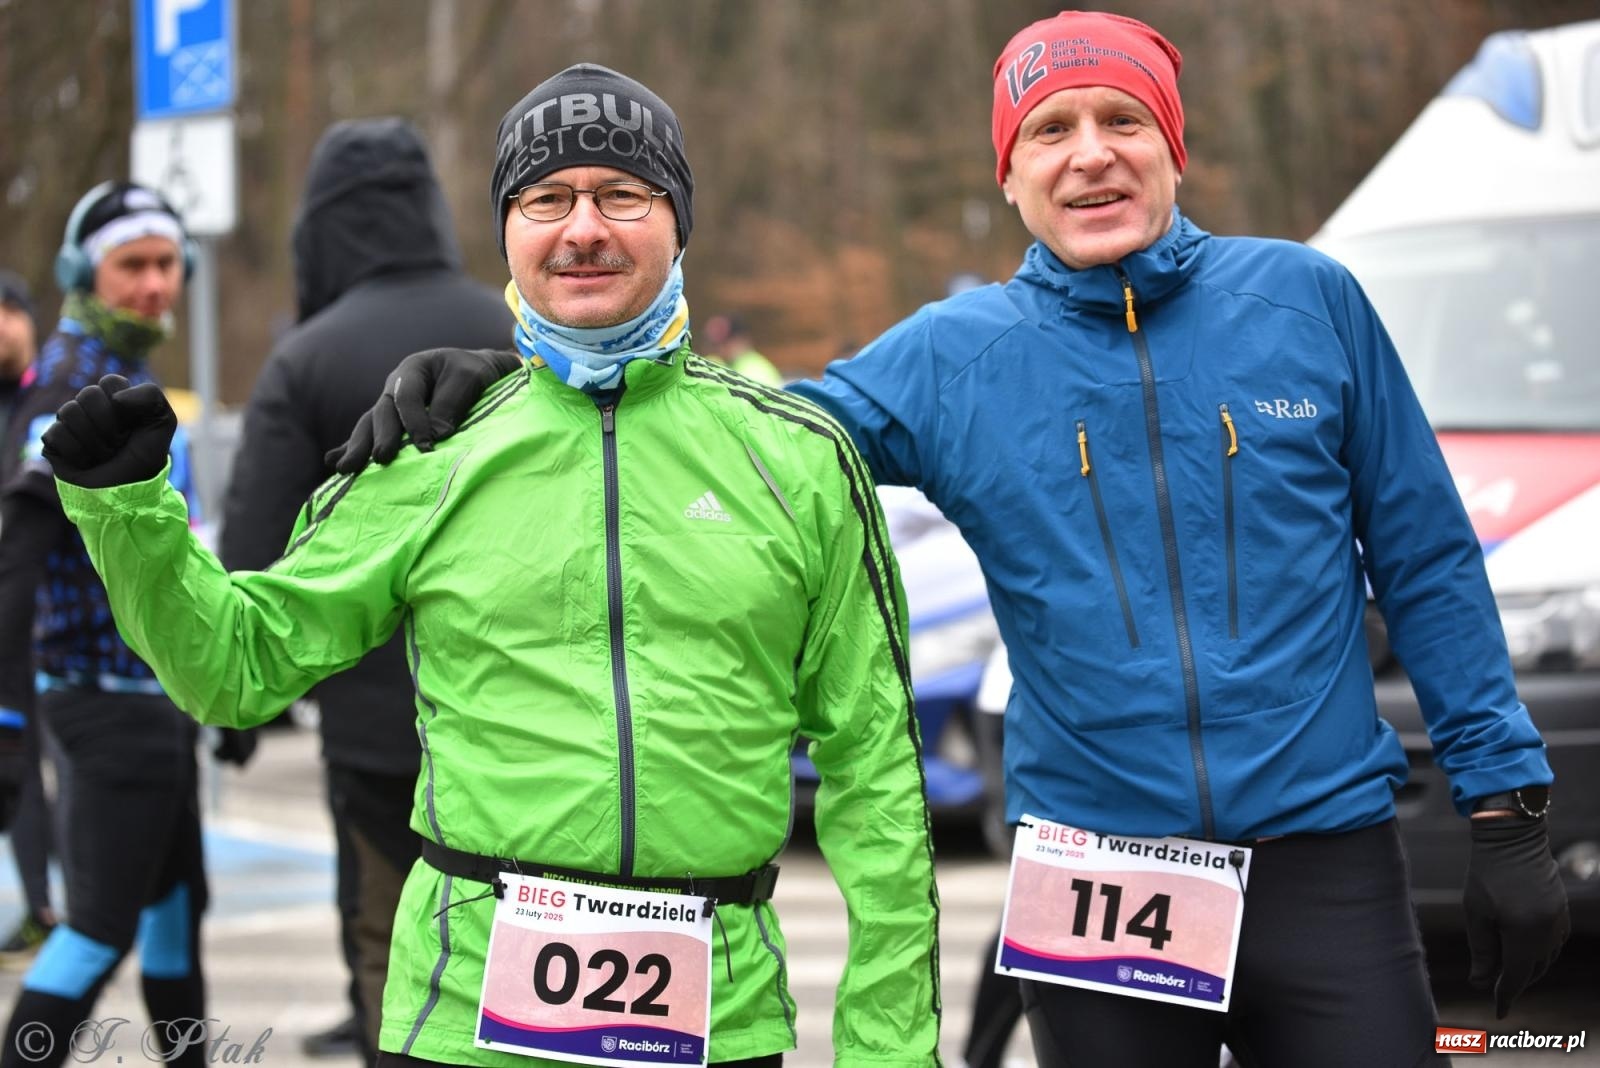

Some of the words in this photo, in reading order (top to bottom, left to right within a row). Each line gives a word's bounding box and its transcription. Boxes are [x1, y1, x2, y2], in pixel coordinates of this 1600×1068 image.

[1051, 48, 1076, 59] Bieg
[1006, 42, 1047, 107] 12
[1273, 398, 1318, 419] Rab
[683, 508, 732, 522] adidas
[1038, 824, 1088, 846] BIEG
[1095, 832, 1226, 870] Twardziela
[1046, 846, 1063, 857] luty
[517, 885, 566, 908] BIEG
[573, 893, 697, 923] Twardziela
[1070, 877, 1173, 951] 114
[515, 907, 525, 916] 23
[525, 909, 542, 921] luty
[543, 912, 564, 922] 2025
[533, 942, 672, 1017] 022
[1132, 969, 1186, 988] Racibórz
[618, 1039, 671, 1053] Racibórz
